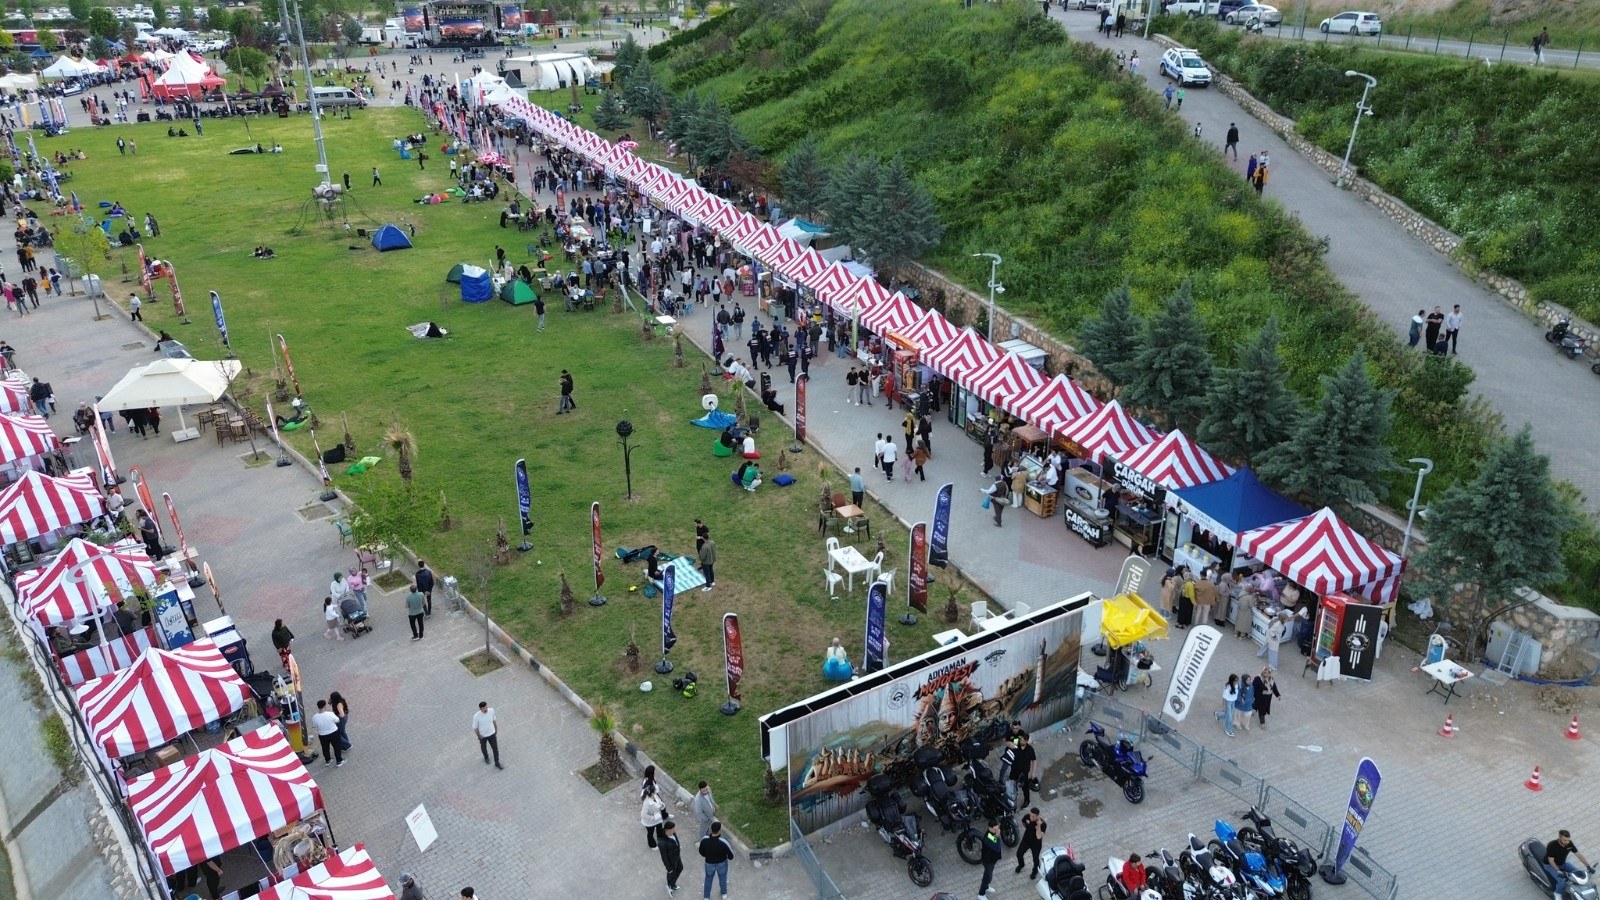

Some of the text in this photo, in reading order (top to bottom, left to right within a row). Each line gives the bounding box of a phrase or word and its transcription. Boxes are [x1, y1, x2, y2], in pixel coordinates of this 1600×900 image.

[1113, 462, 1156, 495] ÇARGAH
[1121, 479, 1144, 497] DÜRÜM
[1065, 508, 1100, 539] ÇARGAH
[1126, 564, 1144, 594] meli
[920, 663, 973, 697] MOTOFEST
[928, 657, 966, 682] ADIYAMAN
